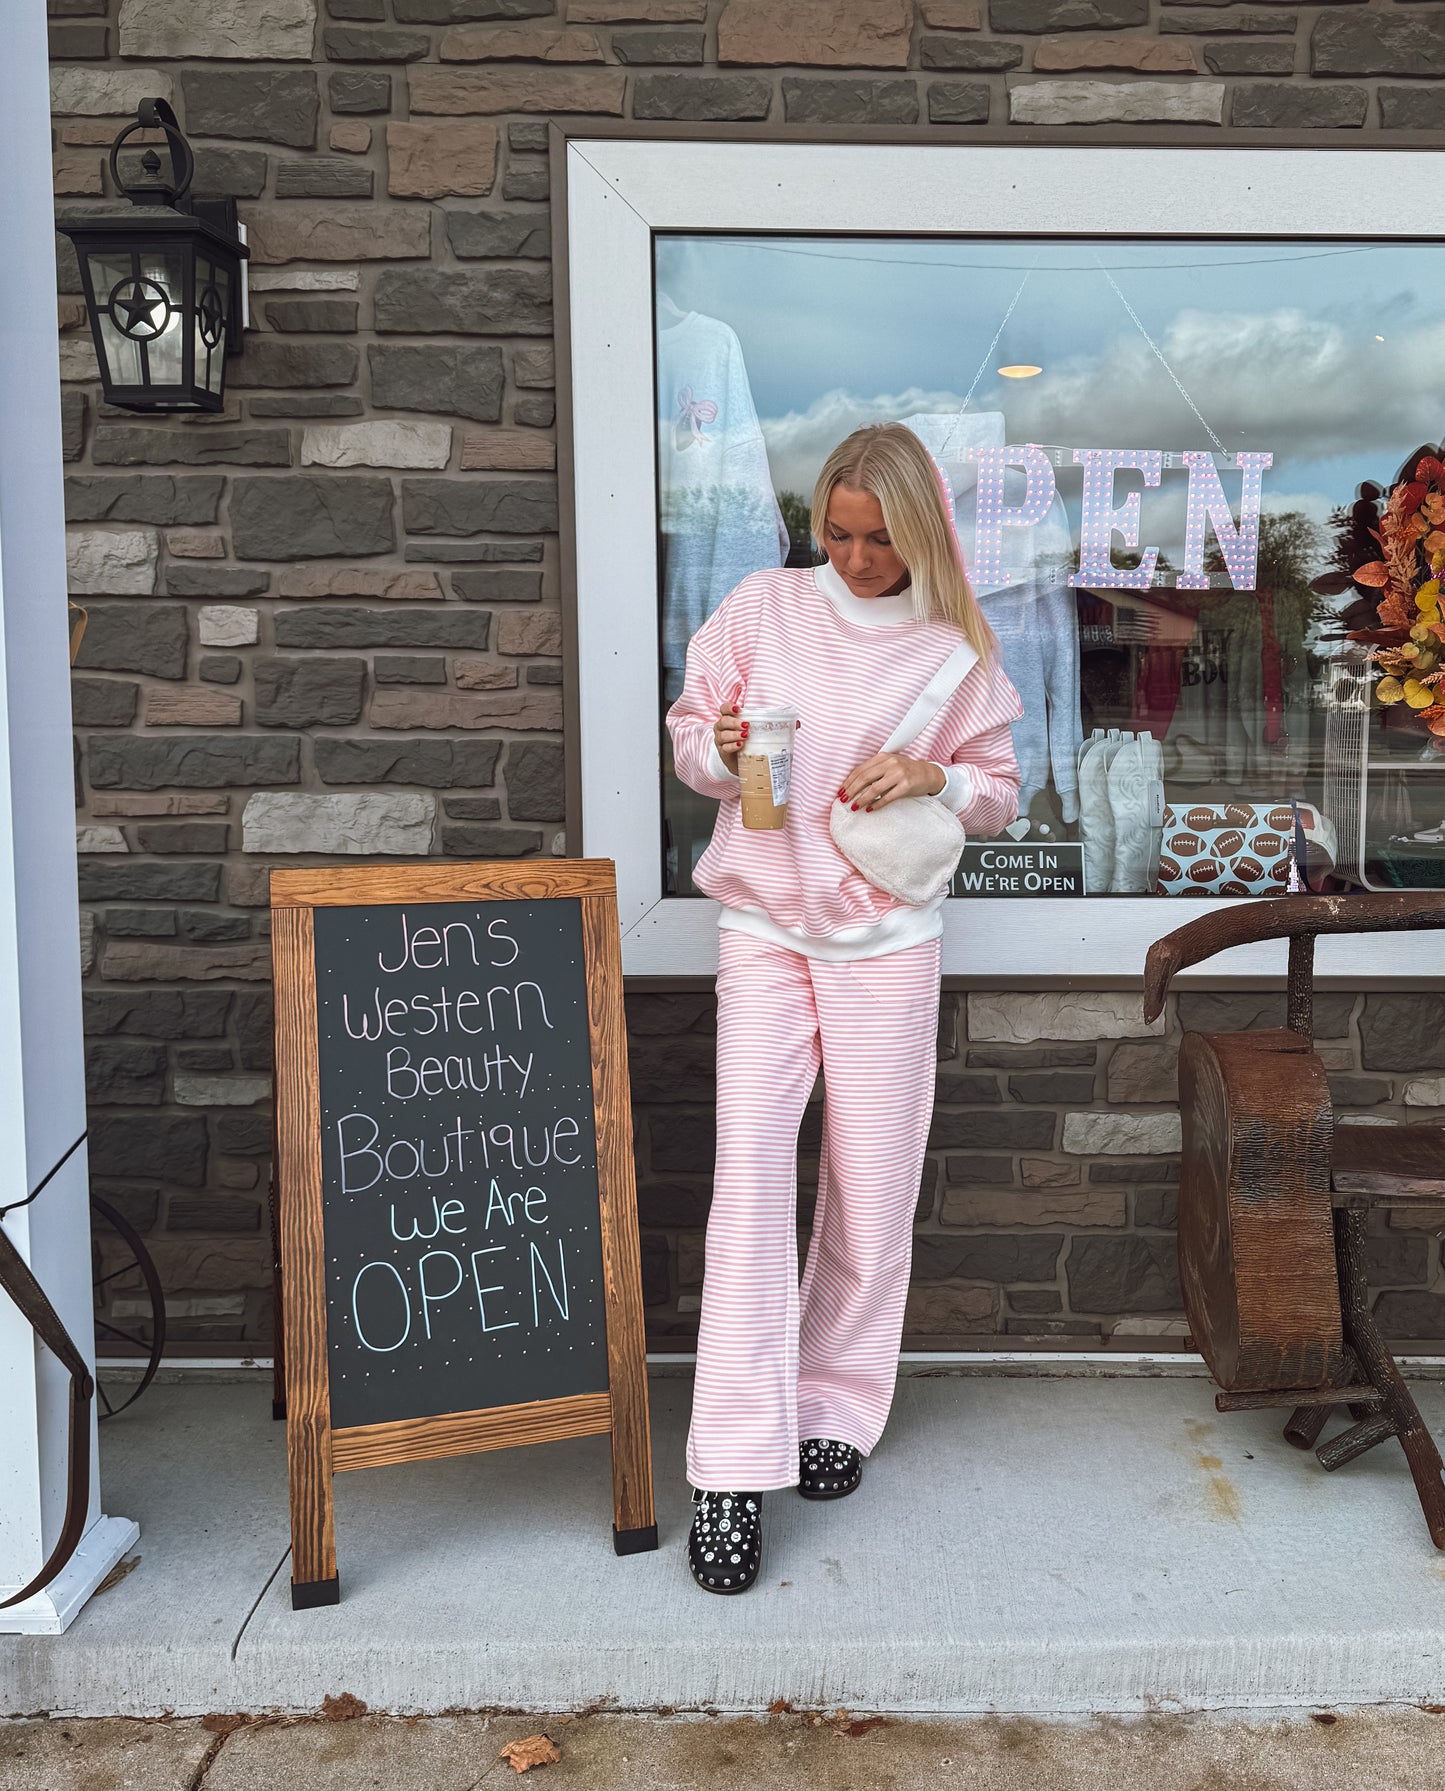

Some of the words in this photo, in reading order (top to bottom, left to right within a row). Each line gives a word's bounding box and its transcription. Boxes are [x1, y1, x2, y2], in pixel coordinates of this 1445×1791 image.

[931, 448, 1274, 590] PEN
[961, 872, 1020, 891] WE'RE
[1024, 872, 1075, 891] OPEN
[980, 850, 1034, 869] COME
[1039, 850, 1058, 869] IN
[378, 913, 519, 973] Jen's
[342, 981, 554, 1041] Western
[386, 1044, 534, 1100] Beauty
[337, 1112, 582, 1194] Boutique
[484, 1178, 549, 1230] Are
[352, 1238, 570, 1352] OPEN
